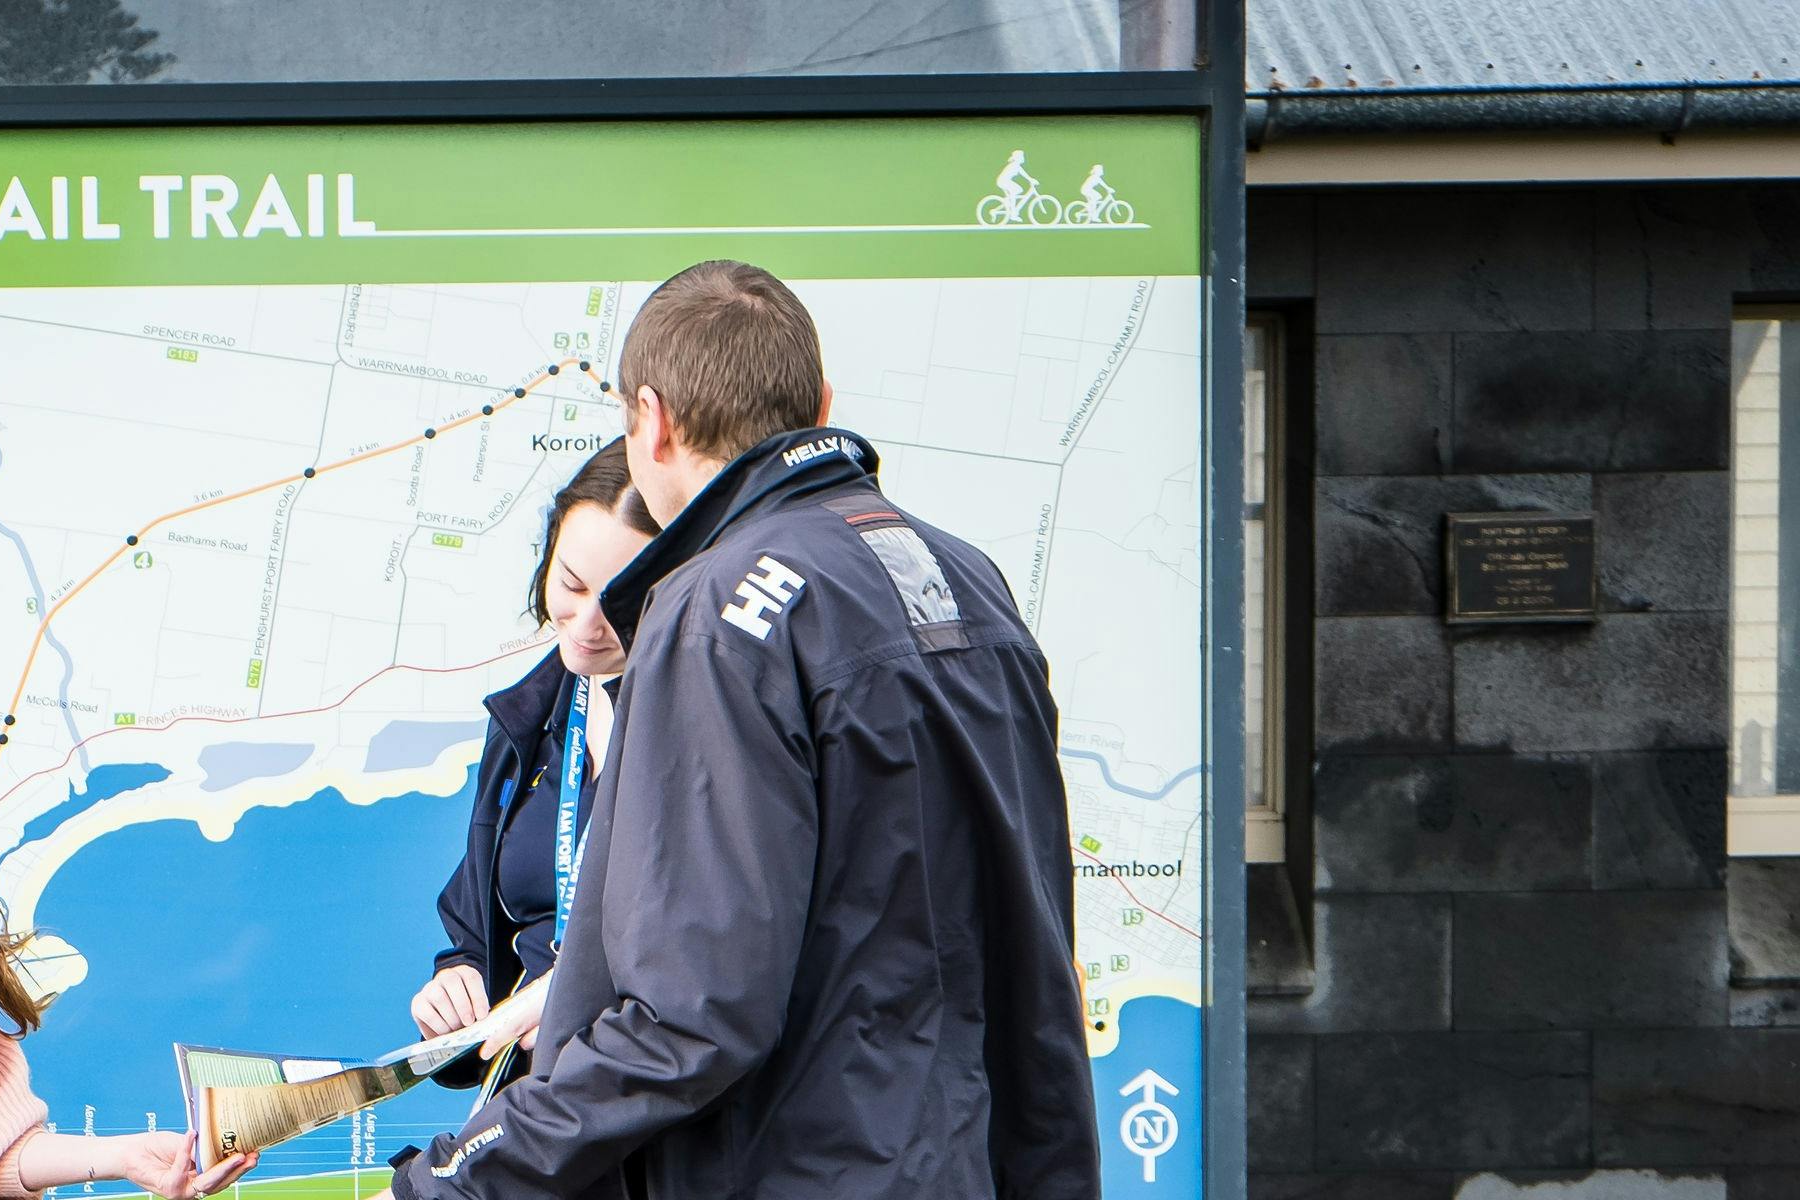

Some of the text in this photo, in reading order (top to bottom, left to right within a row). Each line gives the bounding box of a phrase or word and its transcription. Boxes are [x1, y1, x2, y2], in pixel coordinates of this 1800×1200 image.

[138, 172, 376, 239] TRAIL
[1131, 279, 1149, 312] ROAD
[142, 325, 237, 347] SPENCER ROAD
[357, 357, 489, 385] WARRNAMBOOL ROAD
[532, 434, 603, 451] Koroit
[782, 435, 841, 468] HELLY
[415, 491, 515, 530] PORT FAIRY ROAD
[166, 531, 249, 552] Badhams Road
[720, 555, 807, 641] HH
[70, 701, 99, 713] Road
[1075, 860, 1182, 878] rnambool
[464, 1123, 505, 1157] HELLY
[1133, 1115, 1167, 1144] N
